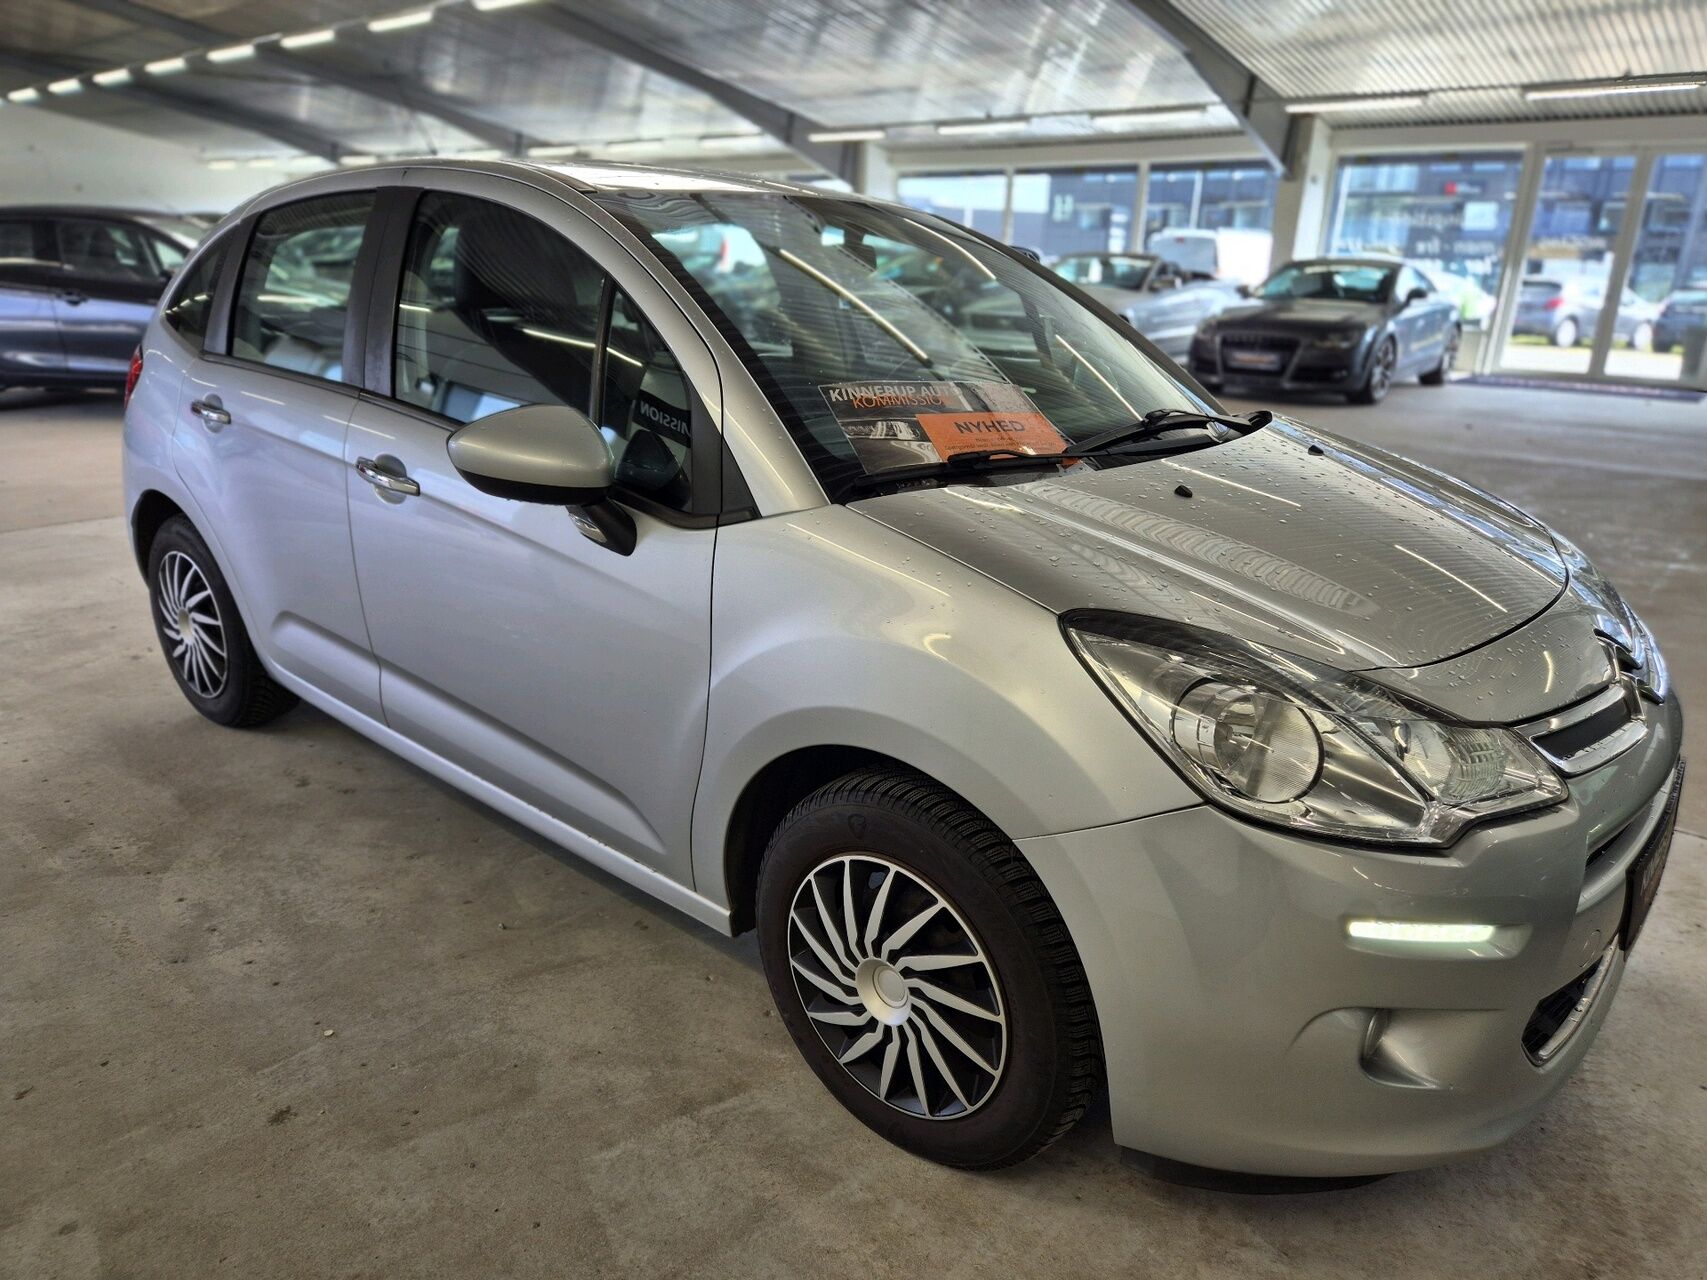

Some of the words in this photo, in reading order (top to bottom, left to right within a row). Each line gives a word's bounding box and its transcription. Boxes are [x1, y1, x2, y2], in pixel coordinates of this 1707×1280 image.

[829, 385, 916, 402] KINNERUP
[852, 393, 953, 409] KOMMISSIO
[953, 420, 1025, 434] NYHED
